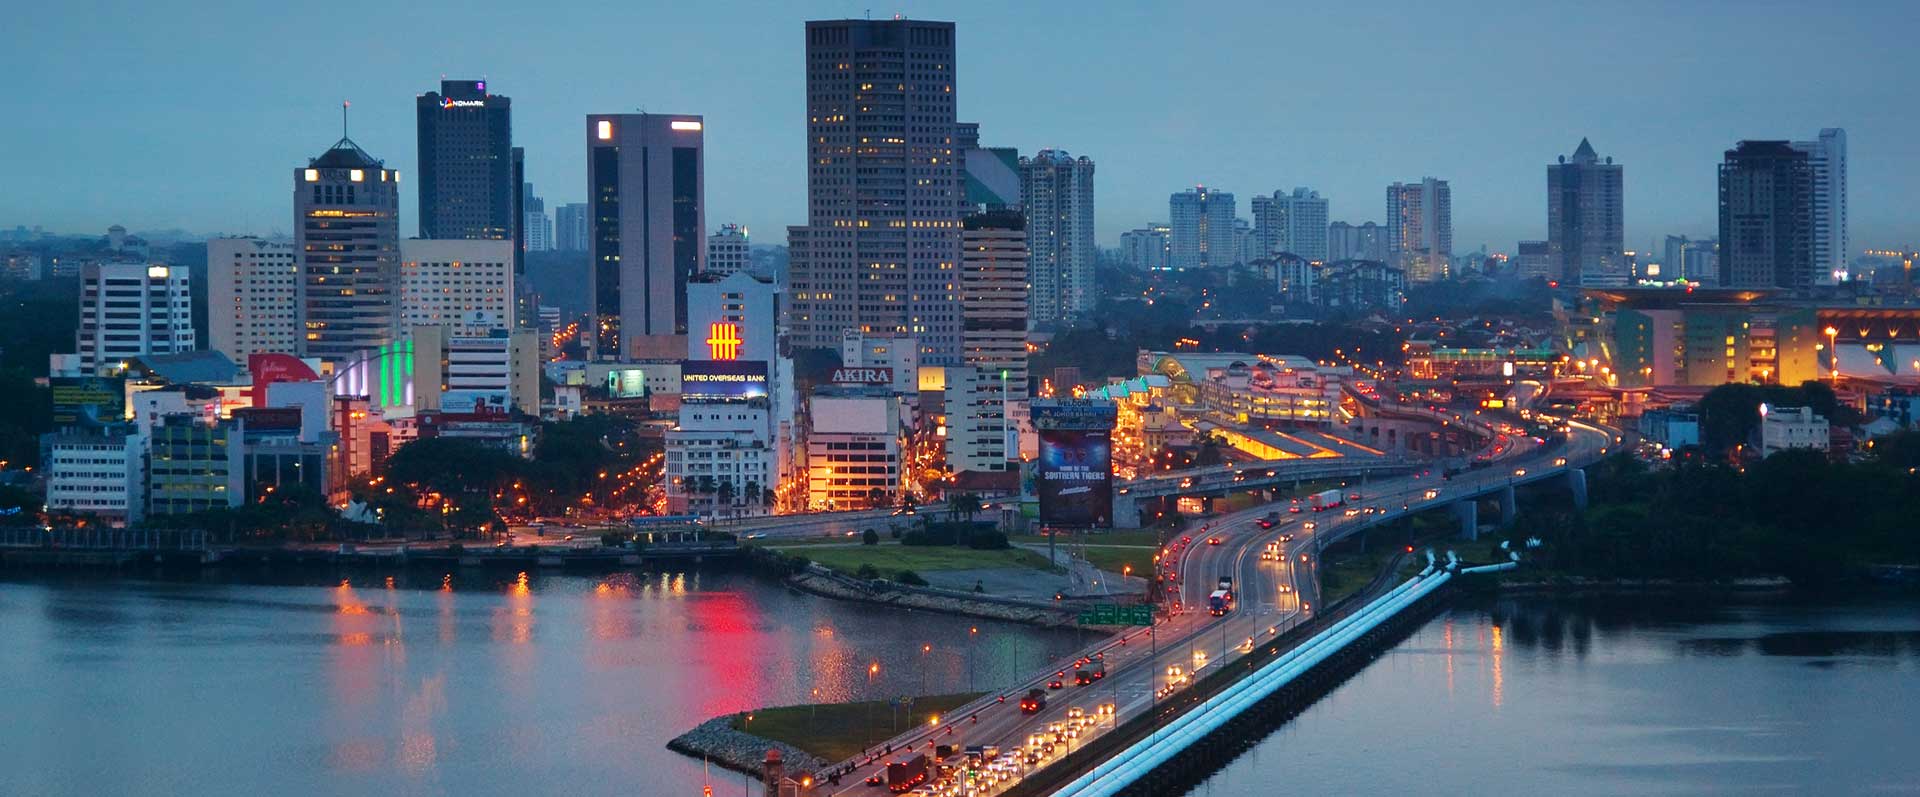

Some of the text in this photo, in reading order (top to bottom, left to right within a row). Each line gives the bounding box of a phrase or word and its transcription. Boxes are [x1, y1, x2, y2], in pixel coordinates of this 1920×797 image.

[439, 97, 484, 108] LANDMARK
[683, 374, 709, 382] UNITED
[709, 374, 746, 382] OVERSEAS
[832, 369, 889, 382] AKIRA
[1056, 399, 1093, 407] WELCOME
[1044, 471, 1105, 480] SOUTHERN TIGERS
